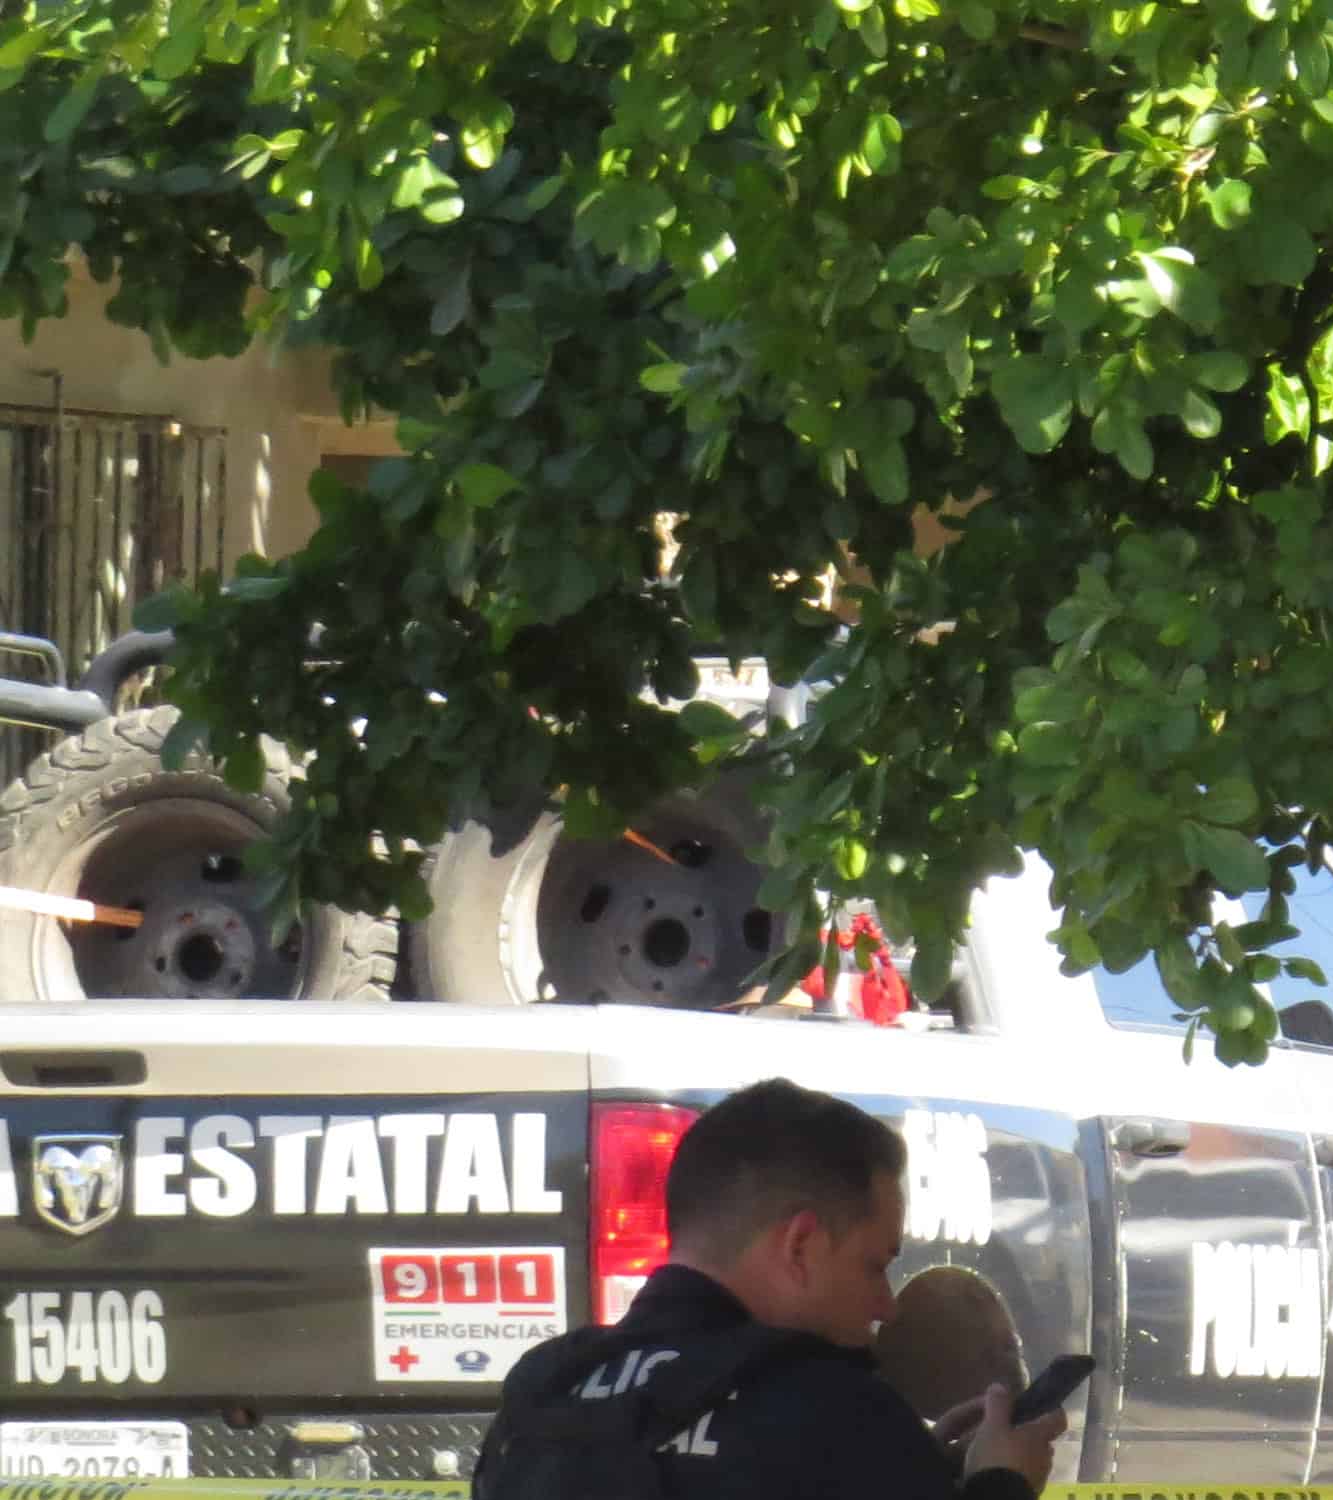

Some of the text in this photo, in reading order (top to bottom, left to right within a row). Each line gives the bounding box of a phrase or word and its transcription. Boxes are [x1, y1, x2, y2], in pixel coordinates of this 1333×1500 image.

[134, 1112, 563, 1216] ESTATAL
[391, 1260, 541, 1299] 911
[5, 1289, 167, 1384] 15406
[384, 1322, 559, 1341] EMERGENCIAS
